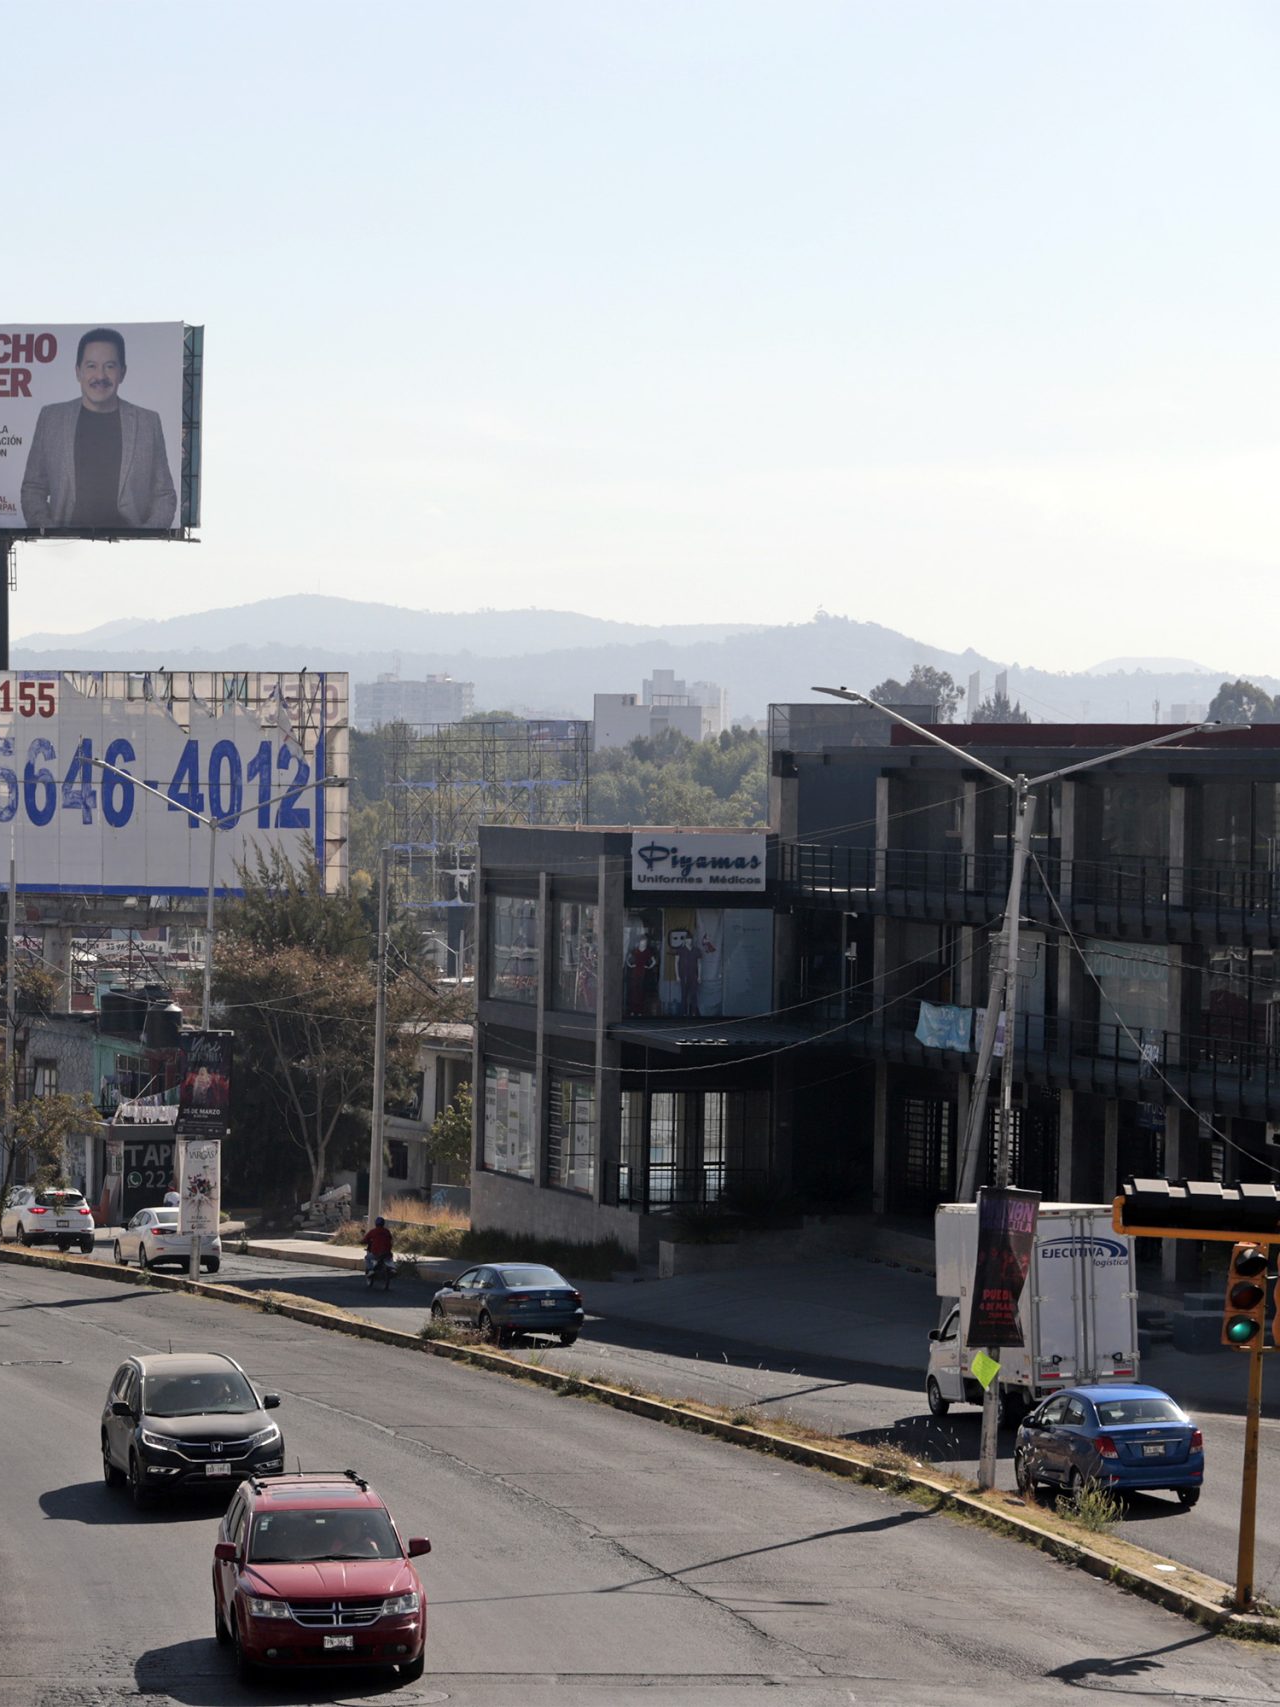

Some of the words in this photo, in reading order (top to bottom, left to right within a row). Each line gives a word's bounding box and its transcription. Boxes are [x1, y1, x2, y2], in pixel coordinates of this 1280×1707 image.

[638, 874, 703, 884] Uniformes
[709, 874, 761, 884] Médicos
[1042, 1247, 1104, 1258] EJECUTIVA
